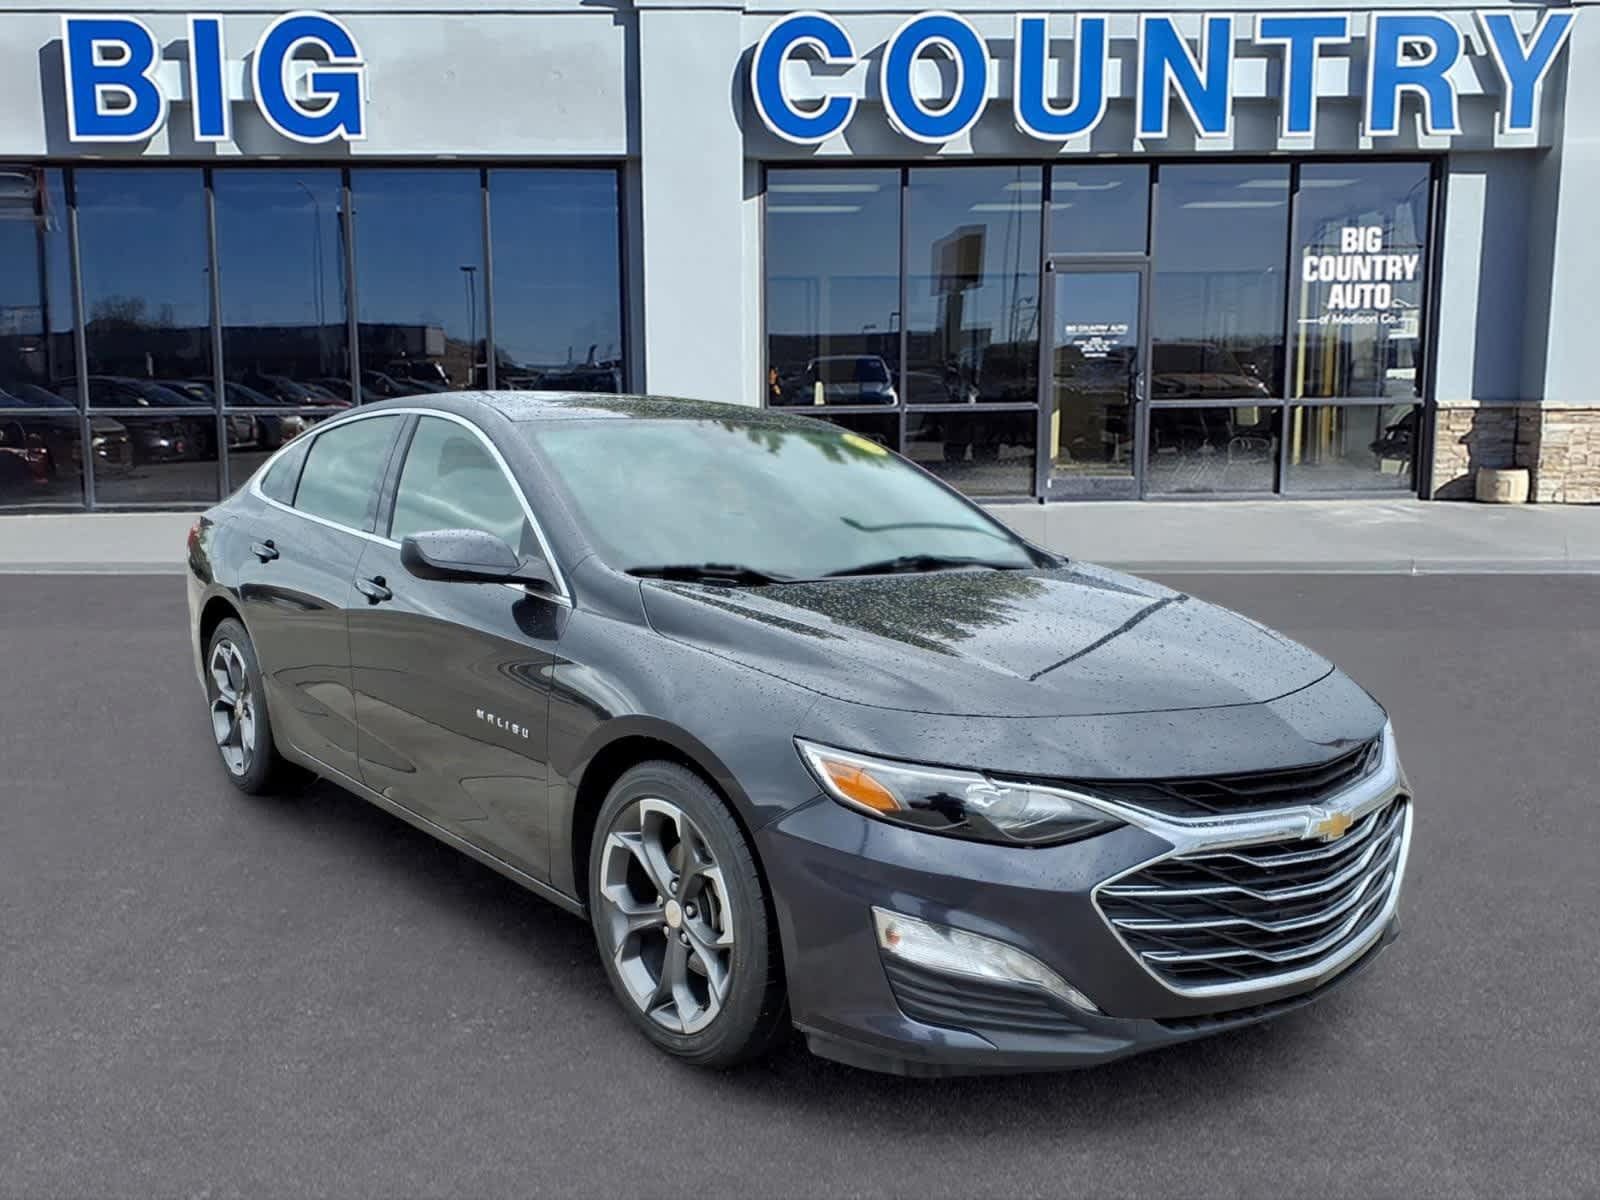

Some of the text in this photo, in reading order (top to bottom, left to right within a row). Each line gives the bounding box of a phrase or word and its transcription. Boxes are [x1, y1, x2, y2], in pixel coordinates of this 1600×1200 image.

[62, 10, 367, 143] BIG
[751, 10, 1574, 145] COUNTRY
[1341, 226, 1383, 253] BIG
[1302, 254, 1419, 282] COUNTRY
[1327, 283, 1392, 309] AUTO
[1332, 313, 1377, 325] Madison
[476, 708, 529, 738] MALIBU
